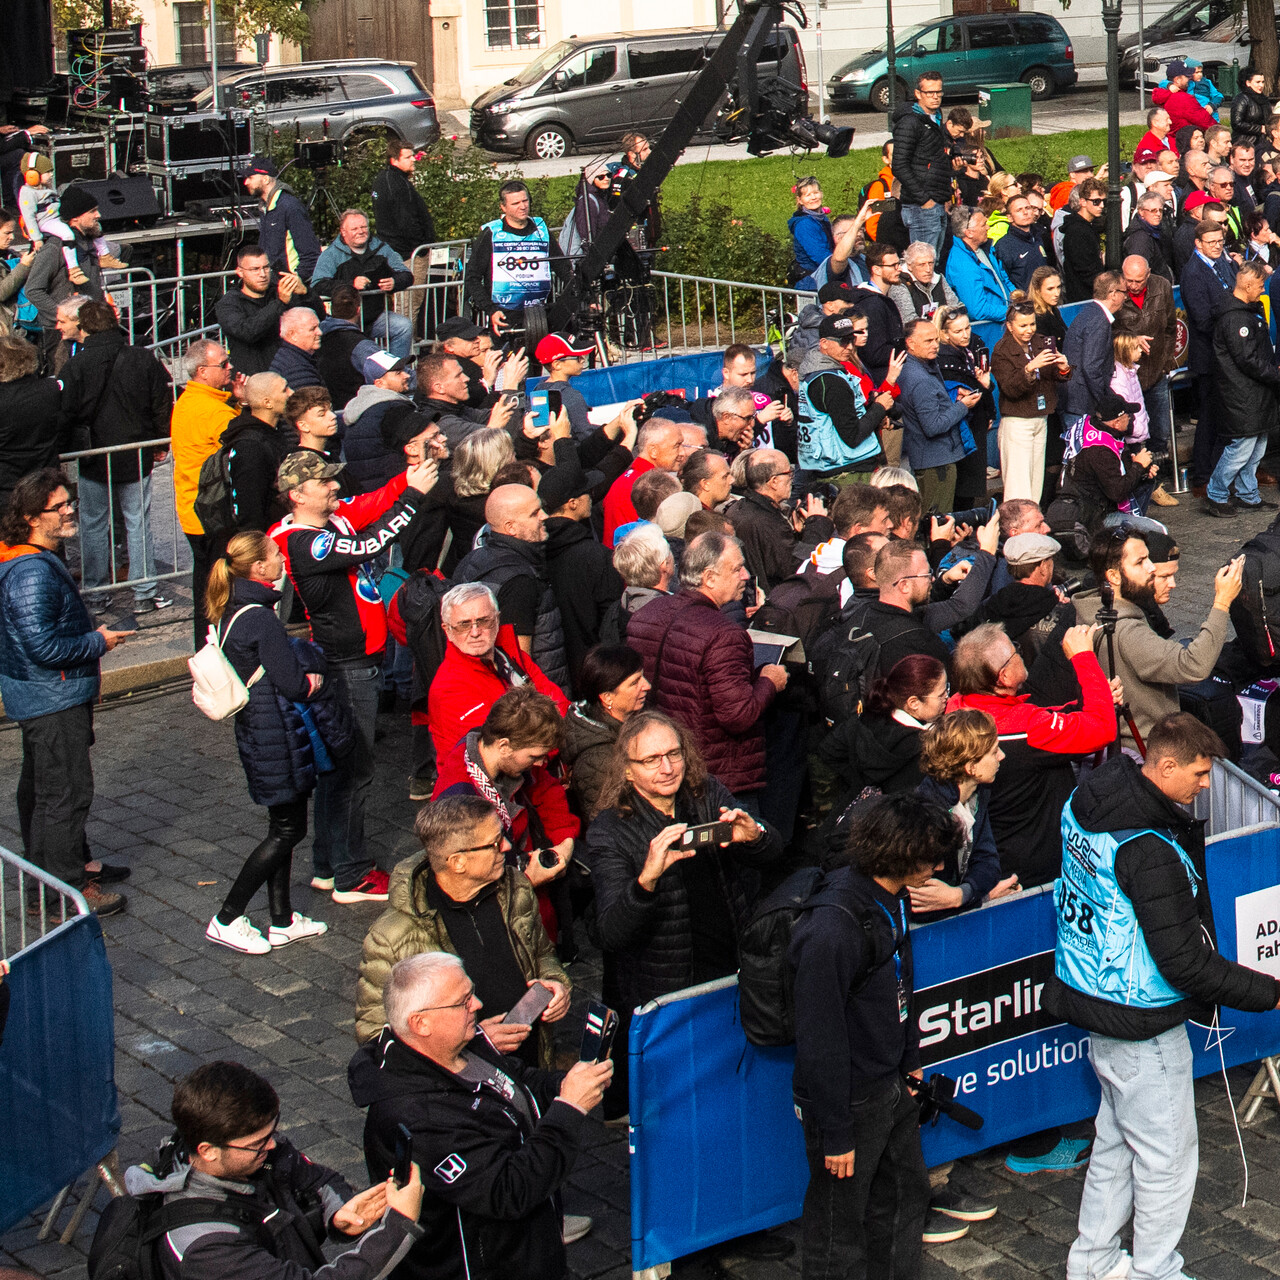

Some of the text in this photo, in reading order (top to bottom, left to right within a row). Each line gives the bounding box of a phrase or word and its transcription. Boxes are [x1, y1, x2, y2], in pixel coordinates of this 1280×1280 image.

[1068, 826, 1100, 870] WRC
[919, 978, 1045, 1048] Starli
[987, 1037, 1091, 1086] solution
